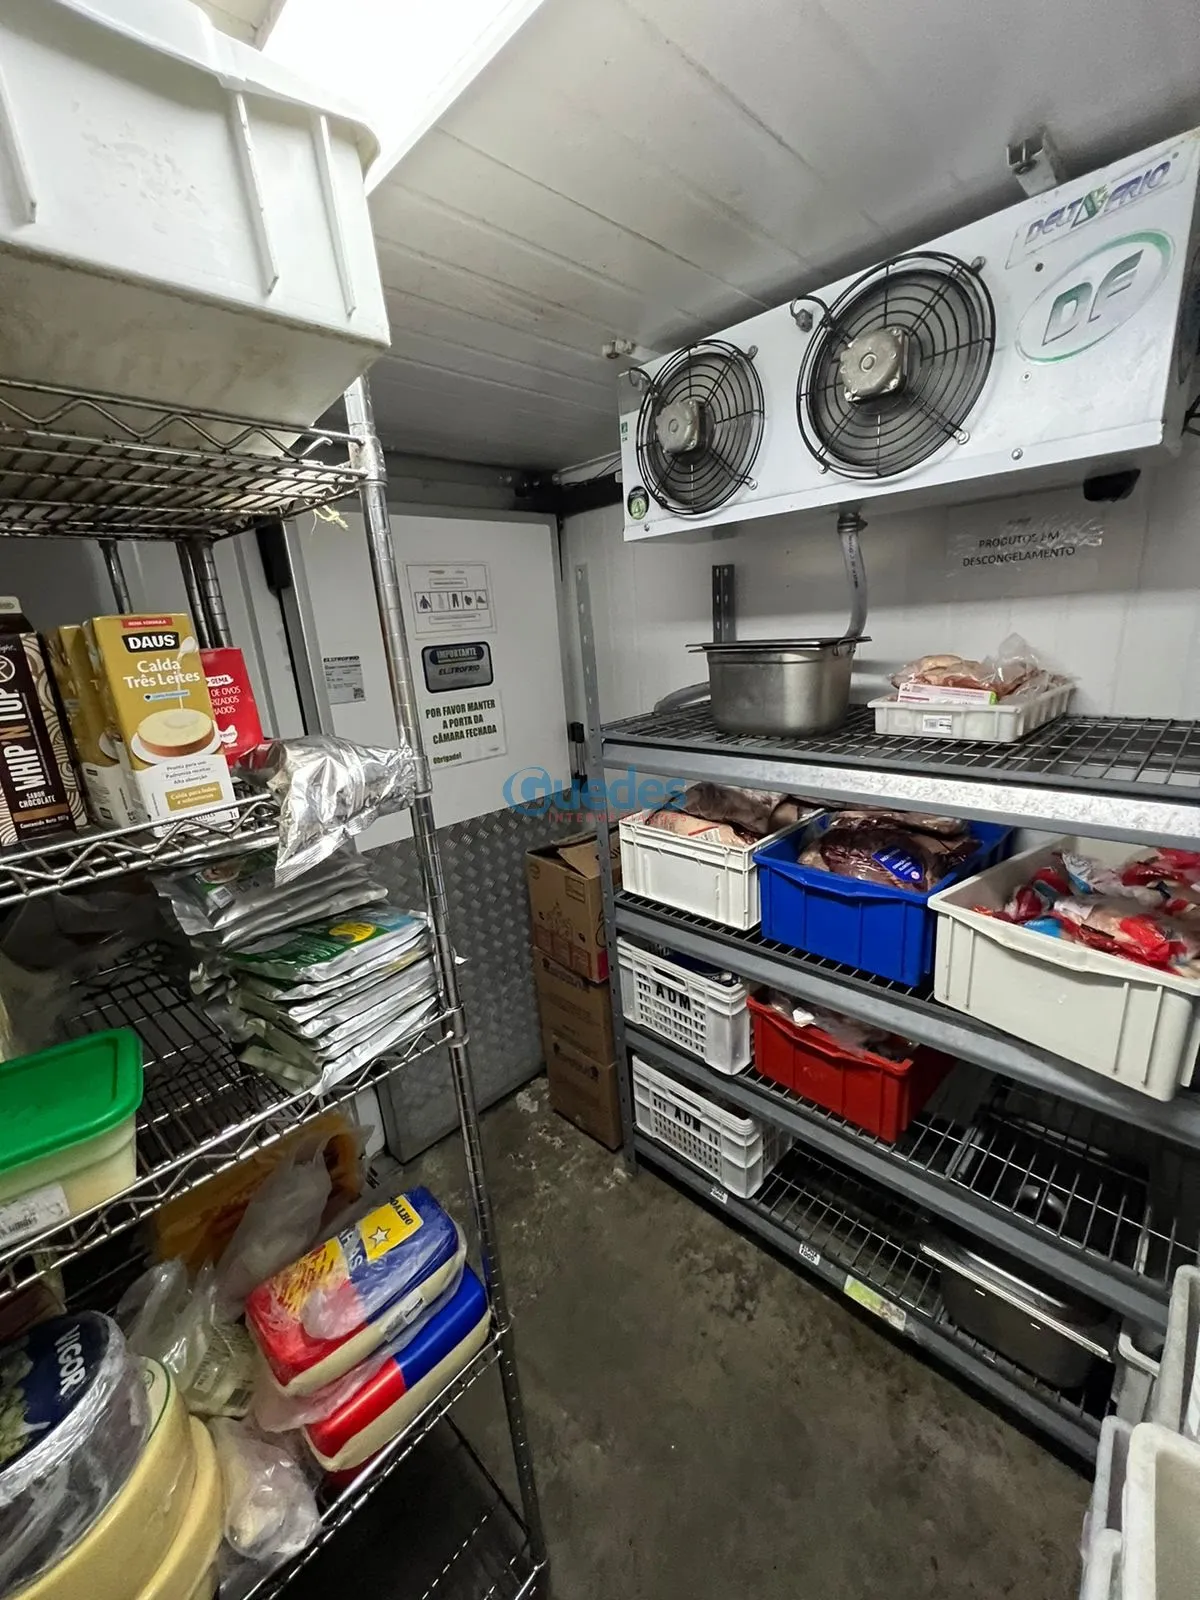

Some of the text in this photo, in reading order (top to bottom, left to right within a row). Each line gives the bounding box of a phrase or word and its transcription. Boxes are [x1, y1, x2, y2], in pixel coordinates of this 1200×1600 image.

[979, 533, 1037, 548] PRODUTOS
[963, 546, 1076, 567] DESCONGELAMENTO
[127, 634, 176, 650] DAUS
[436, 648, 478, 660] IMPORTANTE
[137, 658, 181, 673] Calda
[123, 671, 200, 689] Três Leites
[221, 686, 241, 696] OVOS
[425, 699, 496, 719] POR FAVOR MANTER
[443, 714, 484, 729] A PORTA DA
[433, 724, 497, 744] CÂMARA FECHADA
[19, 795, 56, 808] CHOCOLATE
[26, 790, 46, 799] SABOR
[656, 985, 691, 1011] ADM
[54, 1324, 86, 1395] VIGOR
